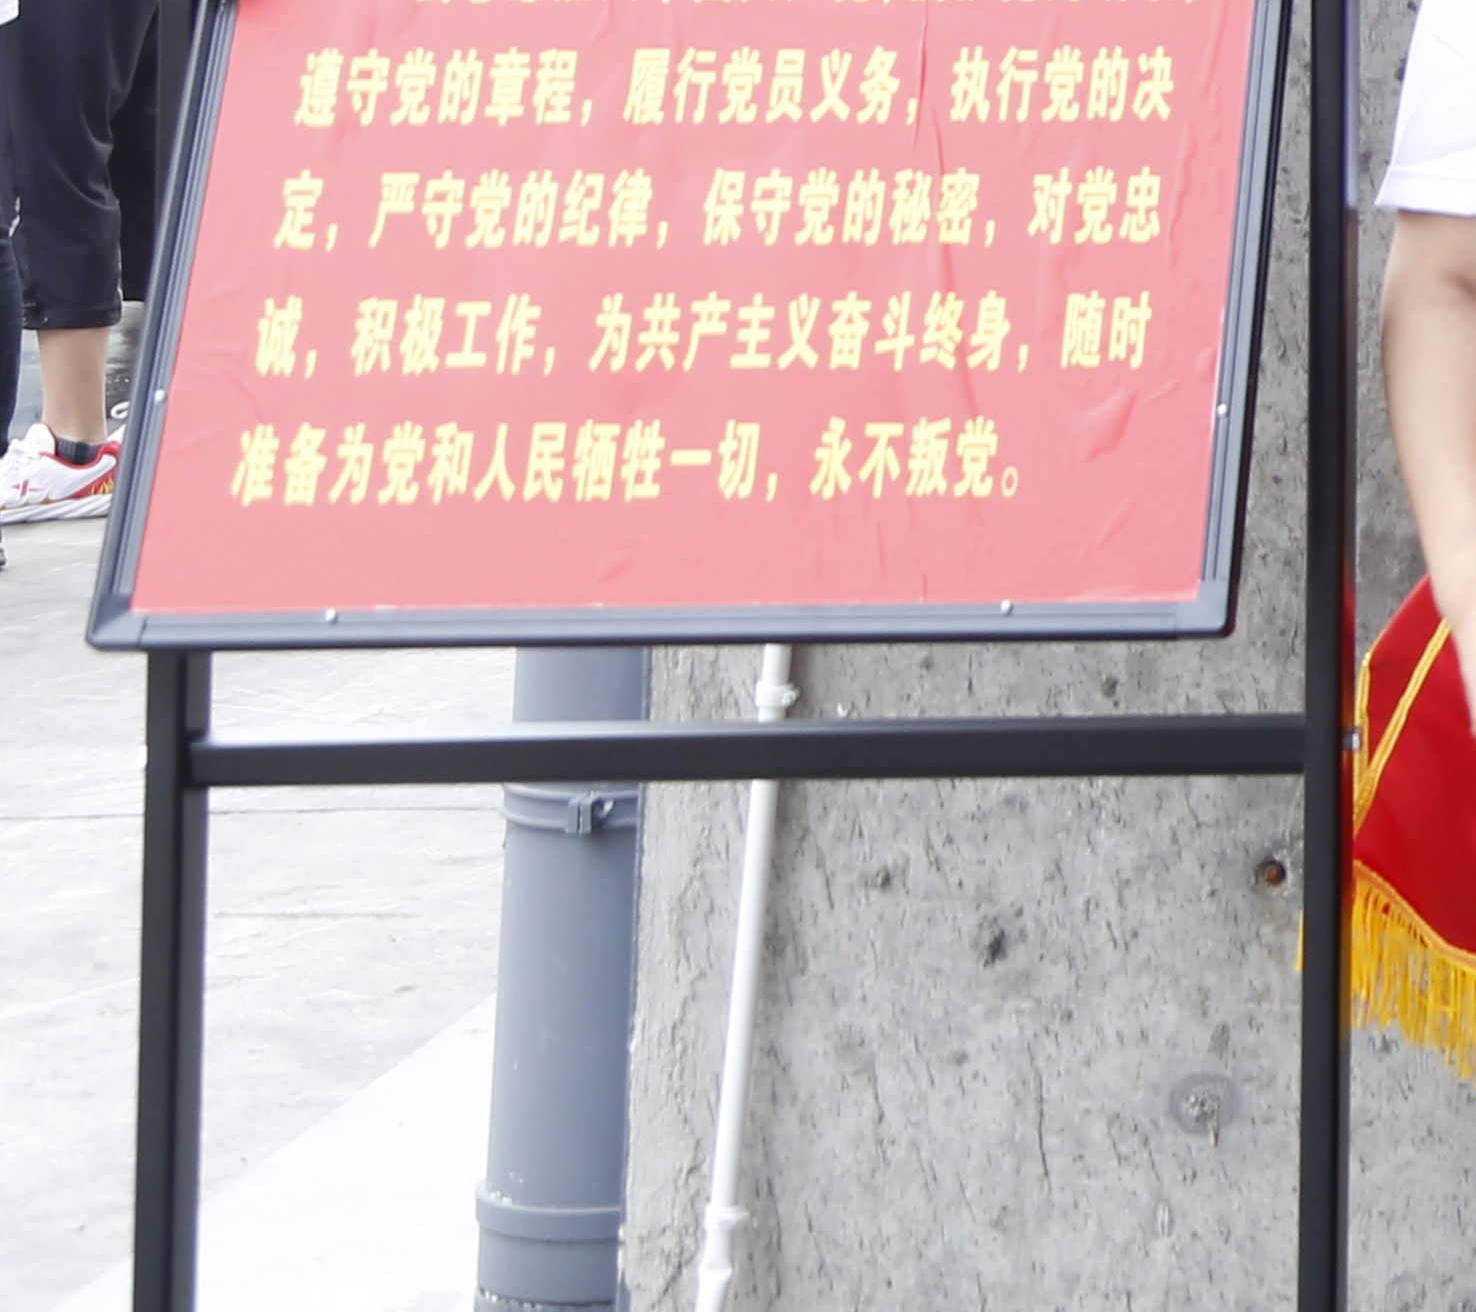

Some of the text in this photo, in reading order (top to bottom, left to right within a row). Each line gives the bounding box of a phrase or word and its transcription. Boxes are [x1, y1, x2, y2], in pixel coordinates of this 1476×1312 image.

[294, 44, 1175, 128] 遵守党的章程，履行党员义务，执行党的决
[272, 165, 1162, 253] 定，严守党的纪律，保守党的秘密，对党忠
[254, 289, 1153, 378] 诚，积极工作，为共产主义奋斗终身，随时
[230, 414, 1019, 507] 准备为党和人民牺牲一切，永不叛党。
